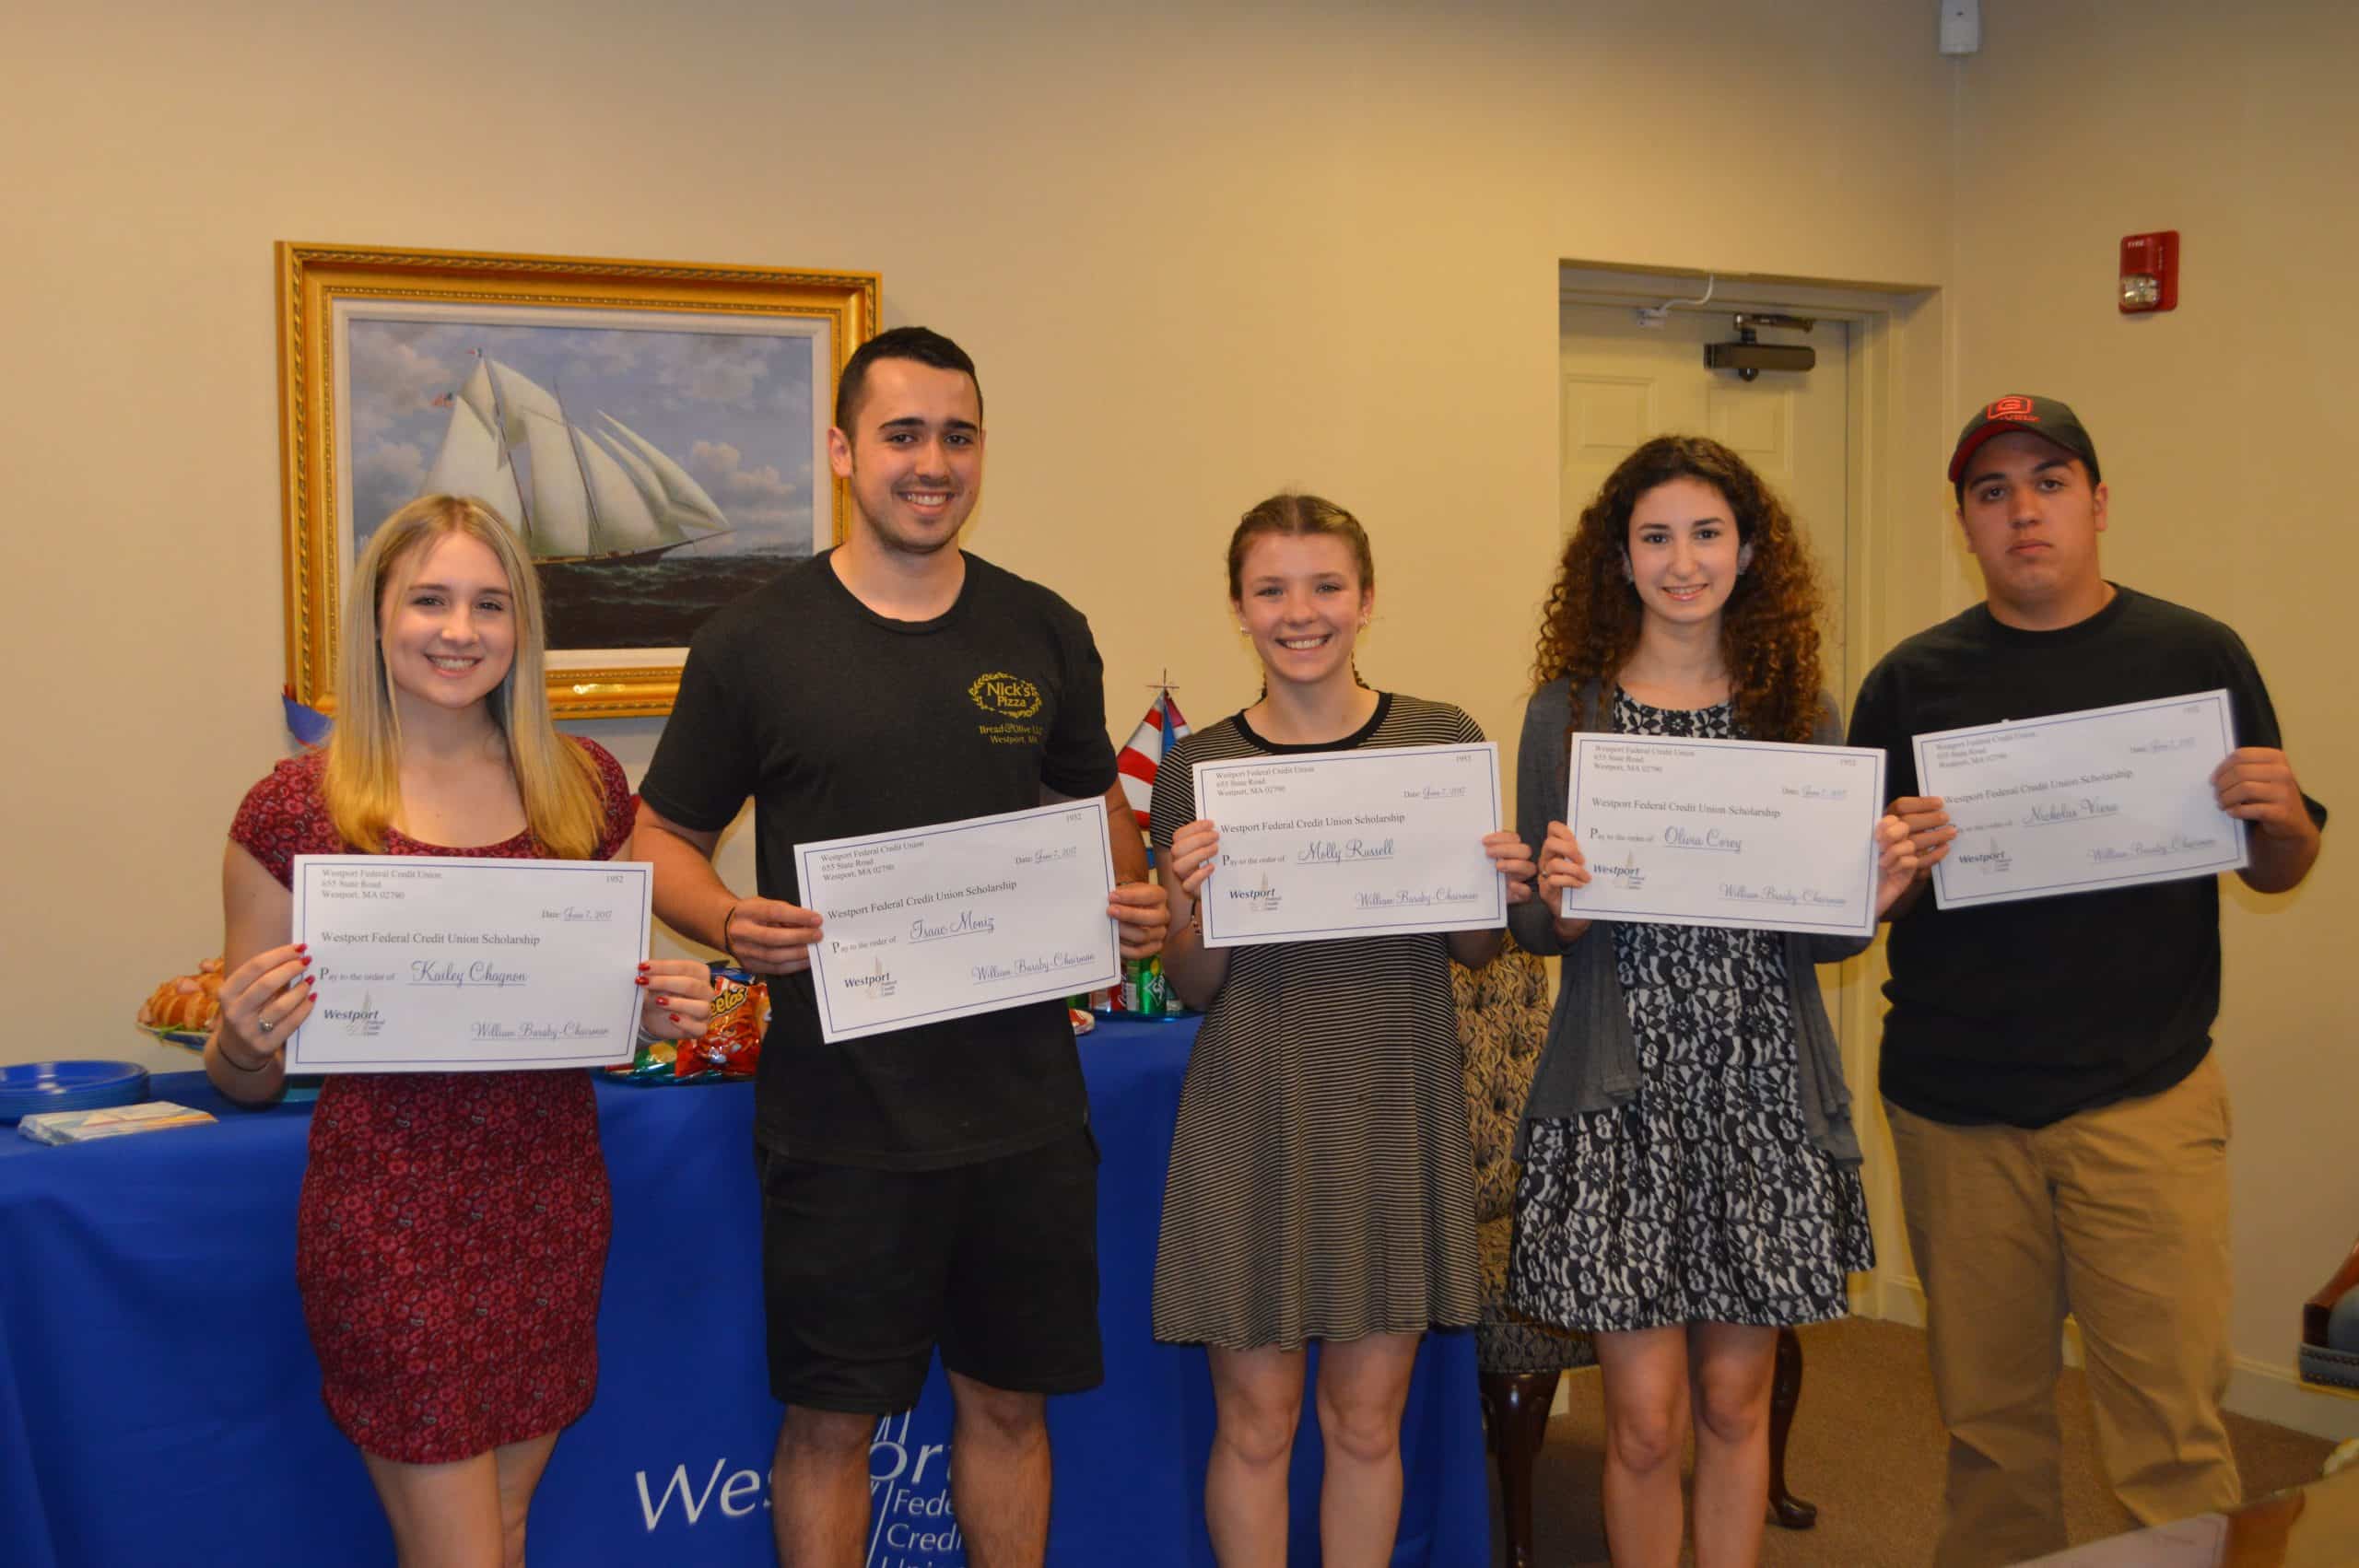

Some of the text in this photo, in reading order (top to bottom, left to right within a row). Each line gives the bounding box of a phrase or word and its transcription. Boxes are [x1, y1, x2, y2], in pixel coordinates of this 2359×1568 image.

[987, 682, 1030, 696] Nick's
[997, 696, 1026, 708] Pizza
[1944, 770, 2132, 803] Westport Federal Credit Union Scholarship
[1592, 798, 1780, 818] Westport Federal Credit Union Scholarship
[1220, 824, 1260, 833] Westport
[1262, 820, 1294, 831] Federal
[1296, 818, 1322, 829] Credit
[1355, 813, 1405, 825] Scholarship
[820, 840, 924, 862] Westport Federal Credit Union
[1297, 837, 1393, 866] Molly Russell
[1959, 851, 2005, 862] Westport
[360, 870, 389, 878] Federal
[417, 871, 442, 879] Union
[1594, 864, 1639, 878] Westport
[827, 881, 1017, 919] Westport Federal Credit Union Scholarship
[1229, 888, 1275, 899] Westport
[321, 932, 540, 945] Westport Federal Credit Union Scholarship
[910, 919, 947, 939] Isaac
[410, 960, 465, 988] Kailey
[844, 973, 890, 988] Westport
[710, 987, 745, 1017] eetos
[324, 1010, 378, 1022] Westport
[886, 1523, 962, 1551] Credi
